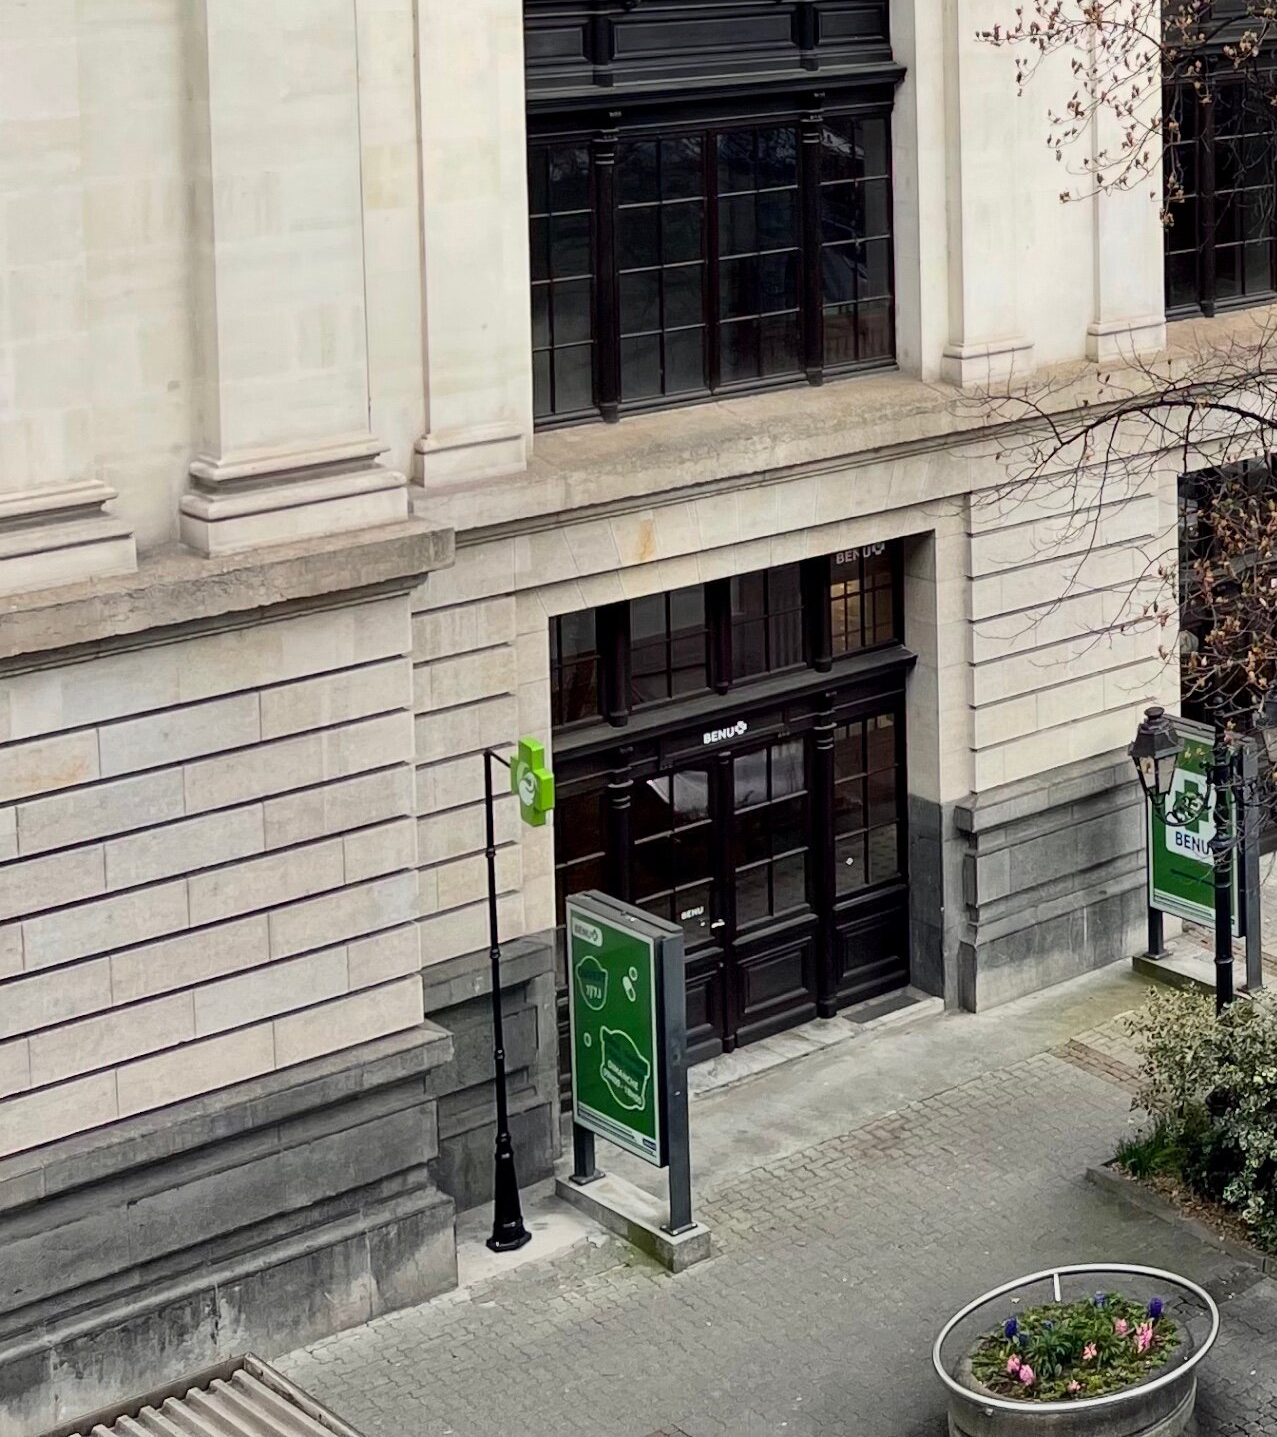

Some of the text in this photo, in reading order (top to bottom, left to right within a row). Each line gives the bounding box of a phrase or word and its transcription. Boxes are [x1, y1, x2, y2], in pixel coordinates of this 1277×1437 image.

[836, 546, 872, 564] BENU
[703, 726, 735, 744] BENU
[1175, 831, 1210, 855] BENU
[681, 905, 704, 920] BENU
